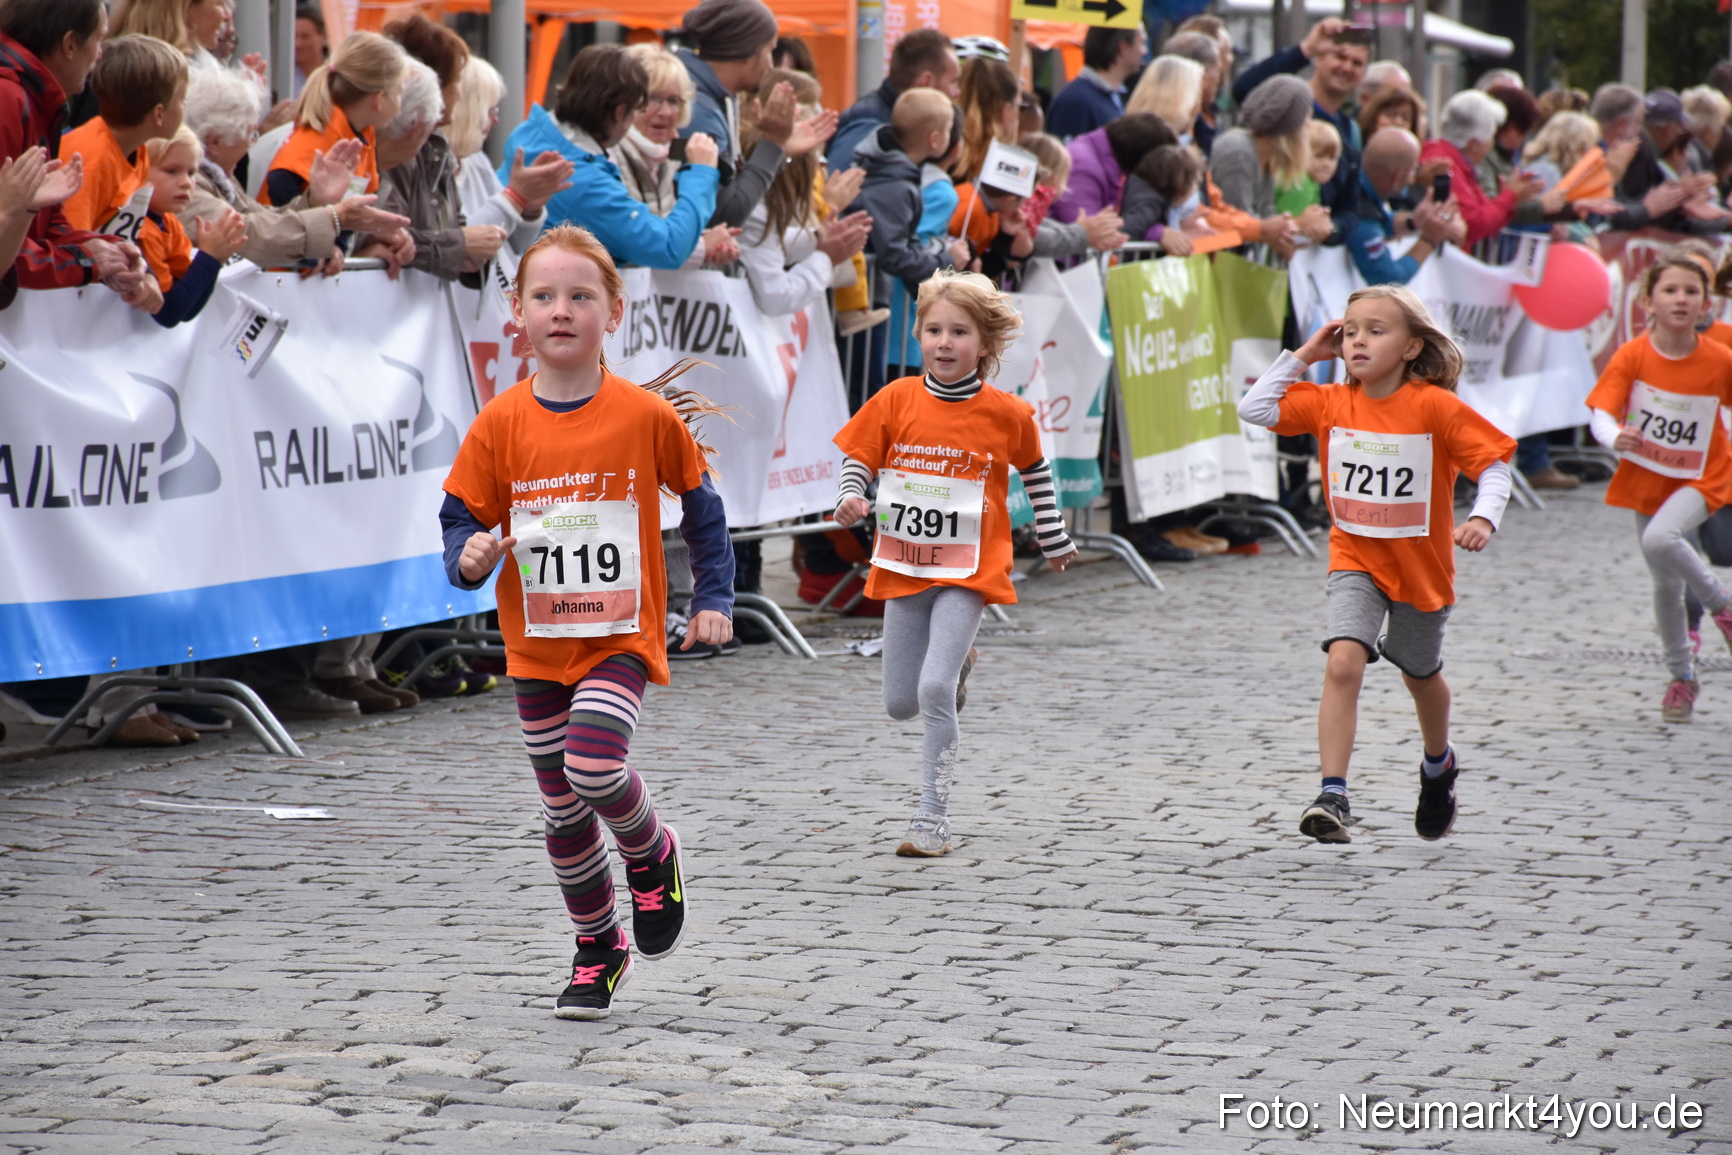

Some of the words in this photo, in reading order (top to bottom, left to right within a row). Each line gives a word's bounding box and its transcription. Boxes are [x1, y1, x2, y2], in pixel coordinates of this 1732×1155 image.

[1124, 323, 1178, 378] Neue
[1640, 409, 1698, 445] 7394
[253, 419, 410, 490] RAIL.ONE
[892, 443, 964, 458] Neumarkter
[1363, 441, 1399, 453] BOCK
[892, 457, 948, 474] Stadtlauf
[511, 472, 597, 494] Neumarkter
[913, 483, 951, 496] BOCK
[1341, 461, 1414, 497] 7212
[553, 515, 598, 527] BOCK
[890, 502, 959, 538] 7391
[1344, 500, 1389, 524] Leni
[529, 543, 621, 585] 7119
[895, 540, 943, 566] JULE
[551, 600, 604, 614] Johanna
